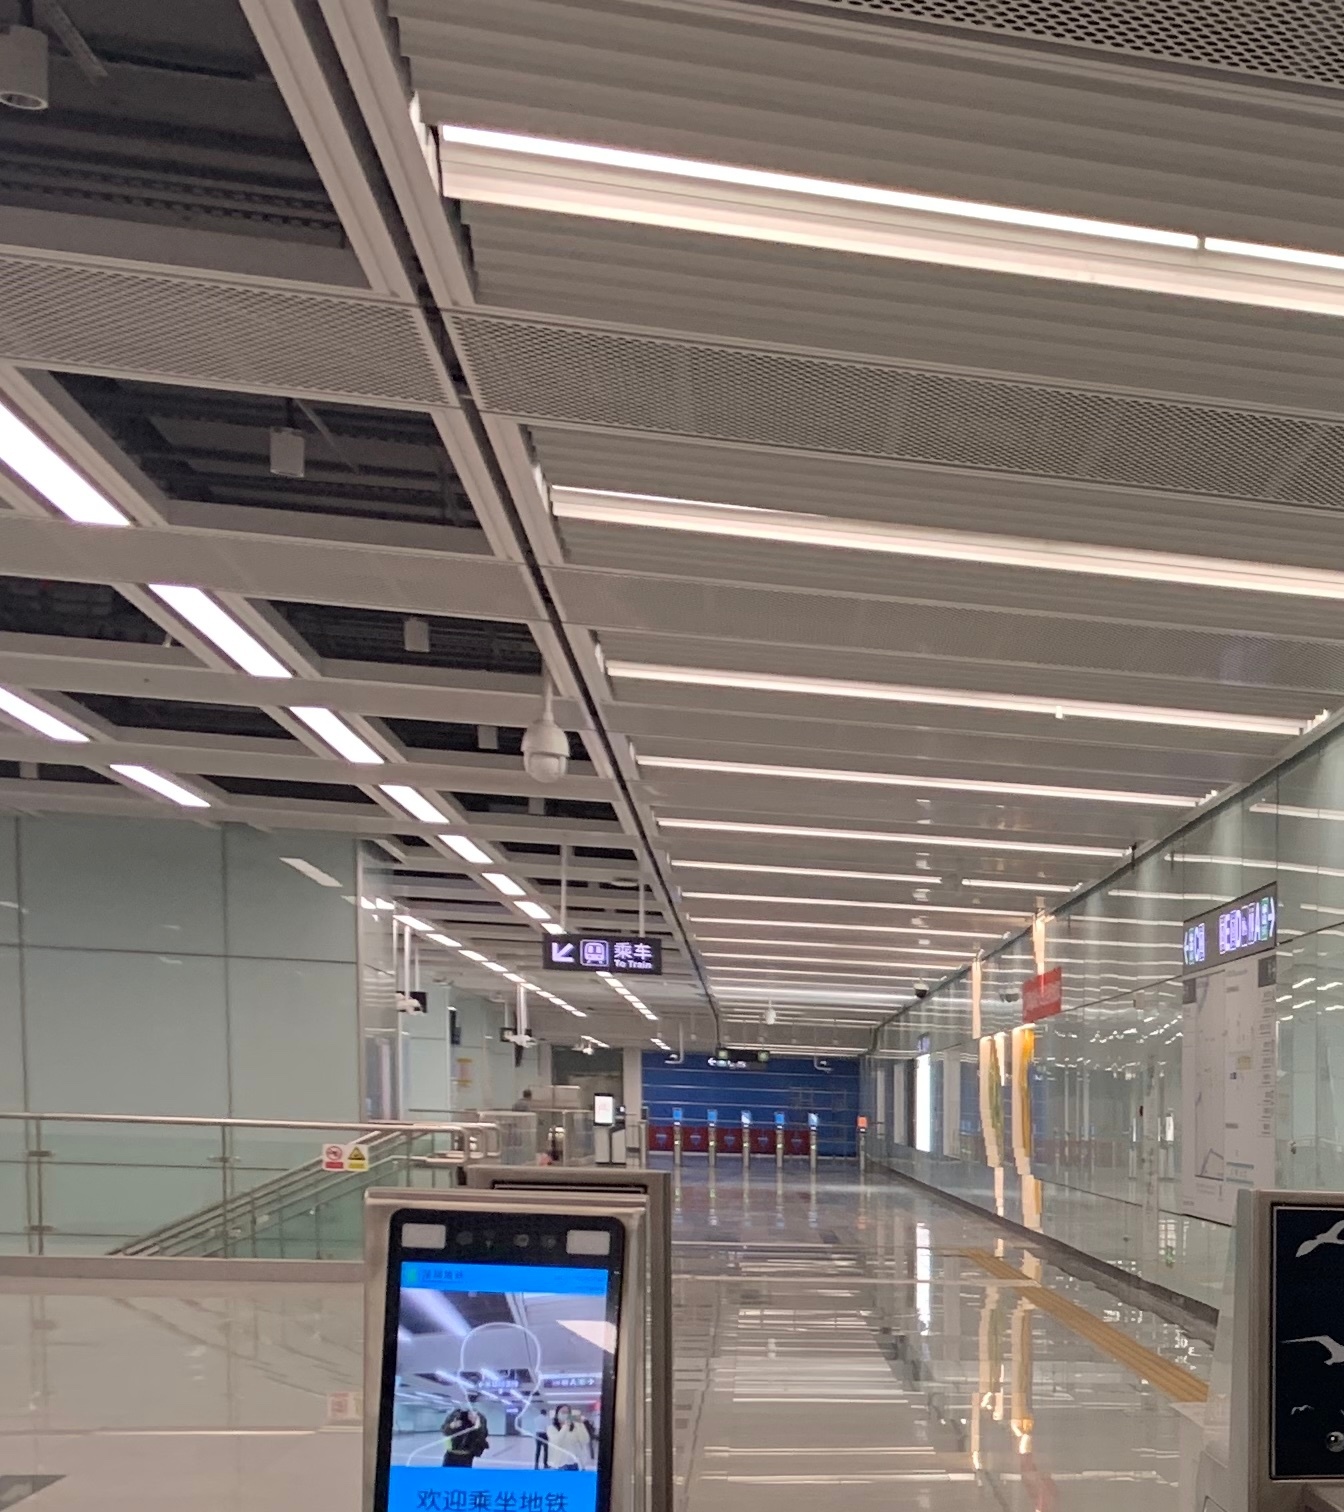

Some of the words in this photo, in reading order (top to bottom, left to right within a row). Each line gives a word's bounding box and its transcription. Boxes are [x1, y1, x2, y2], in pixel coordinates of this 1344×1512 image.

[613, 942, 653, 960] 乘车
[613, 959, 627, 968] To
[627, 960, 653, 969] Train
